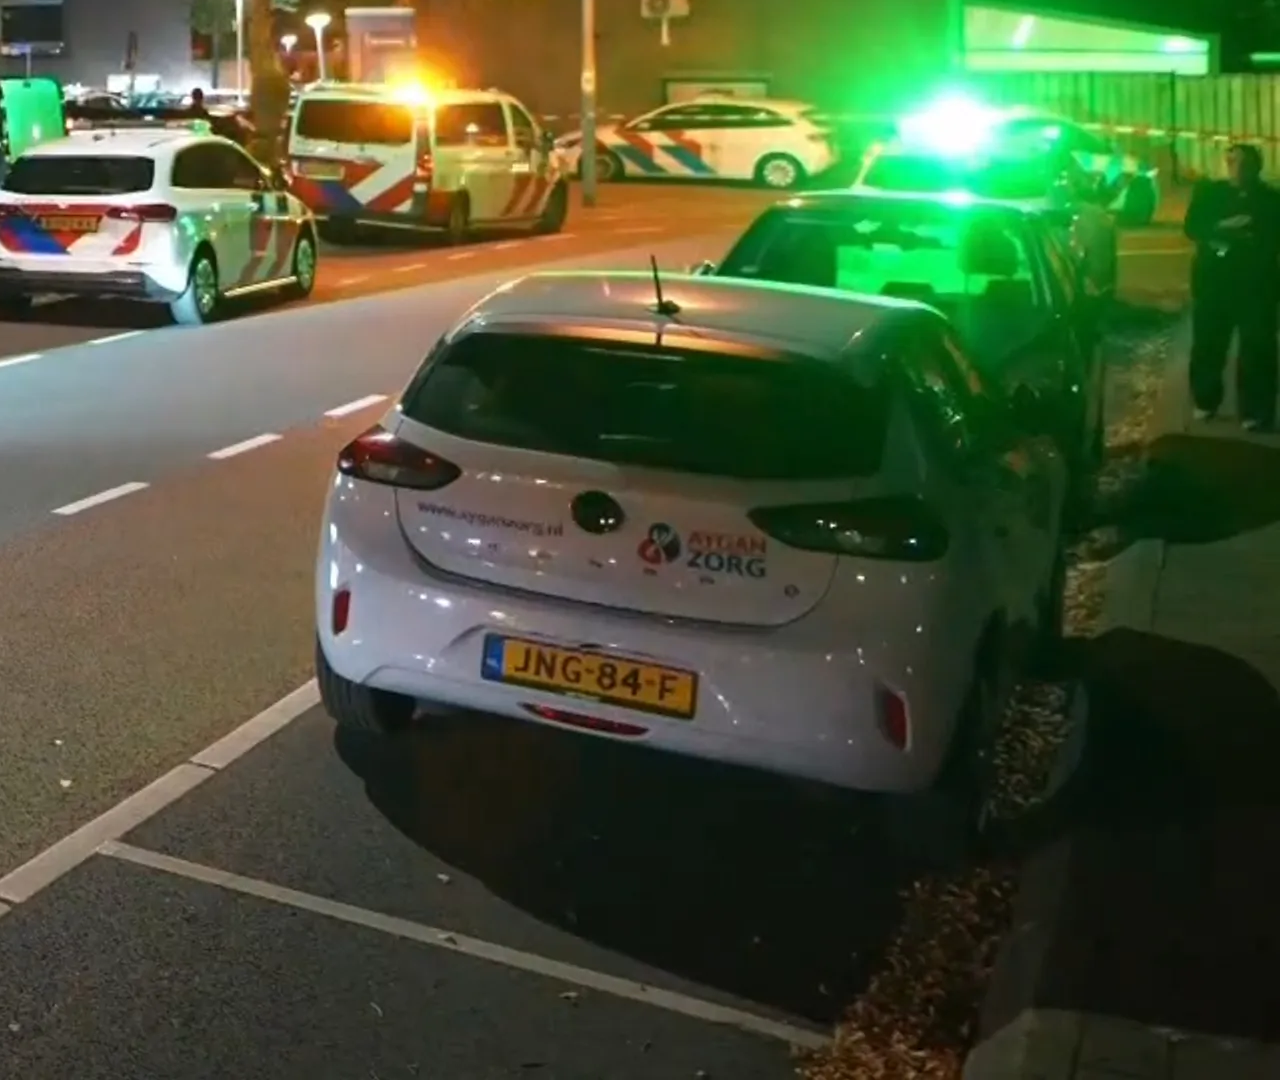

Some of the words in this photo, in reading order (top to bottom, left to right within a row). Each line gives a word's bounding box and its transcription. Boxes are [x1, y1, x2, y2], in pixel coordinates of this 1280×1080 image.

[687, 530, 767, 556] AYGAN
[686, 550, 767, 579] ZORG
[513, 646, 679, 702] JNG-84-F
